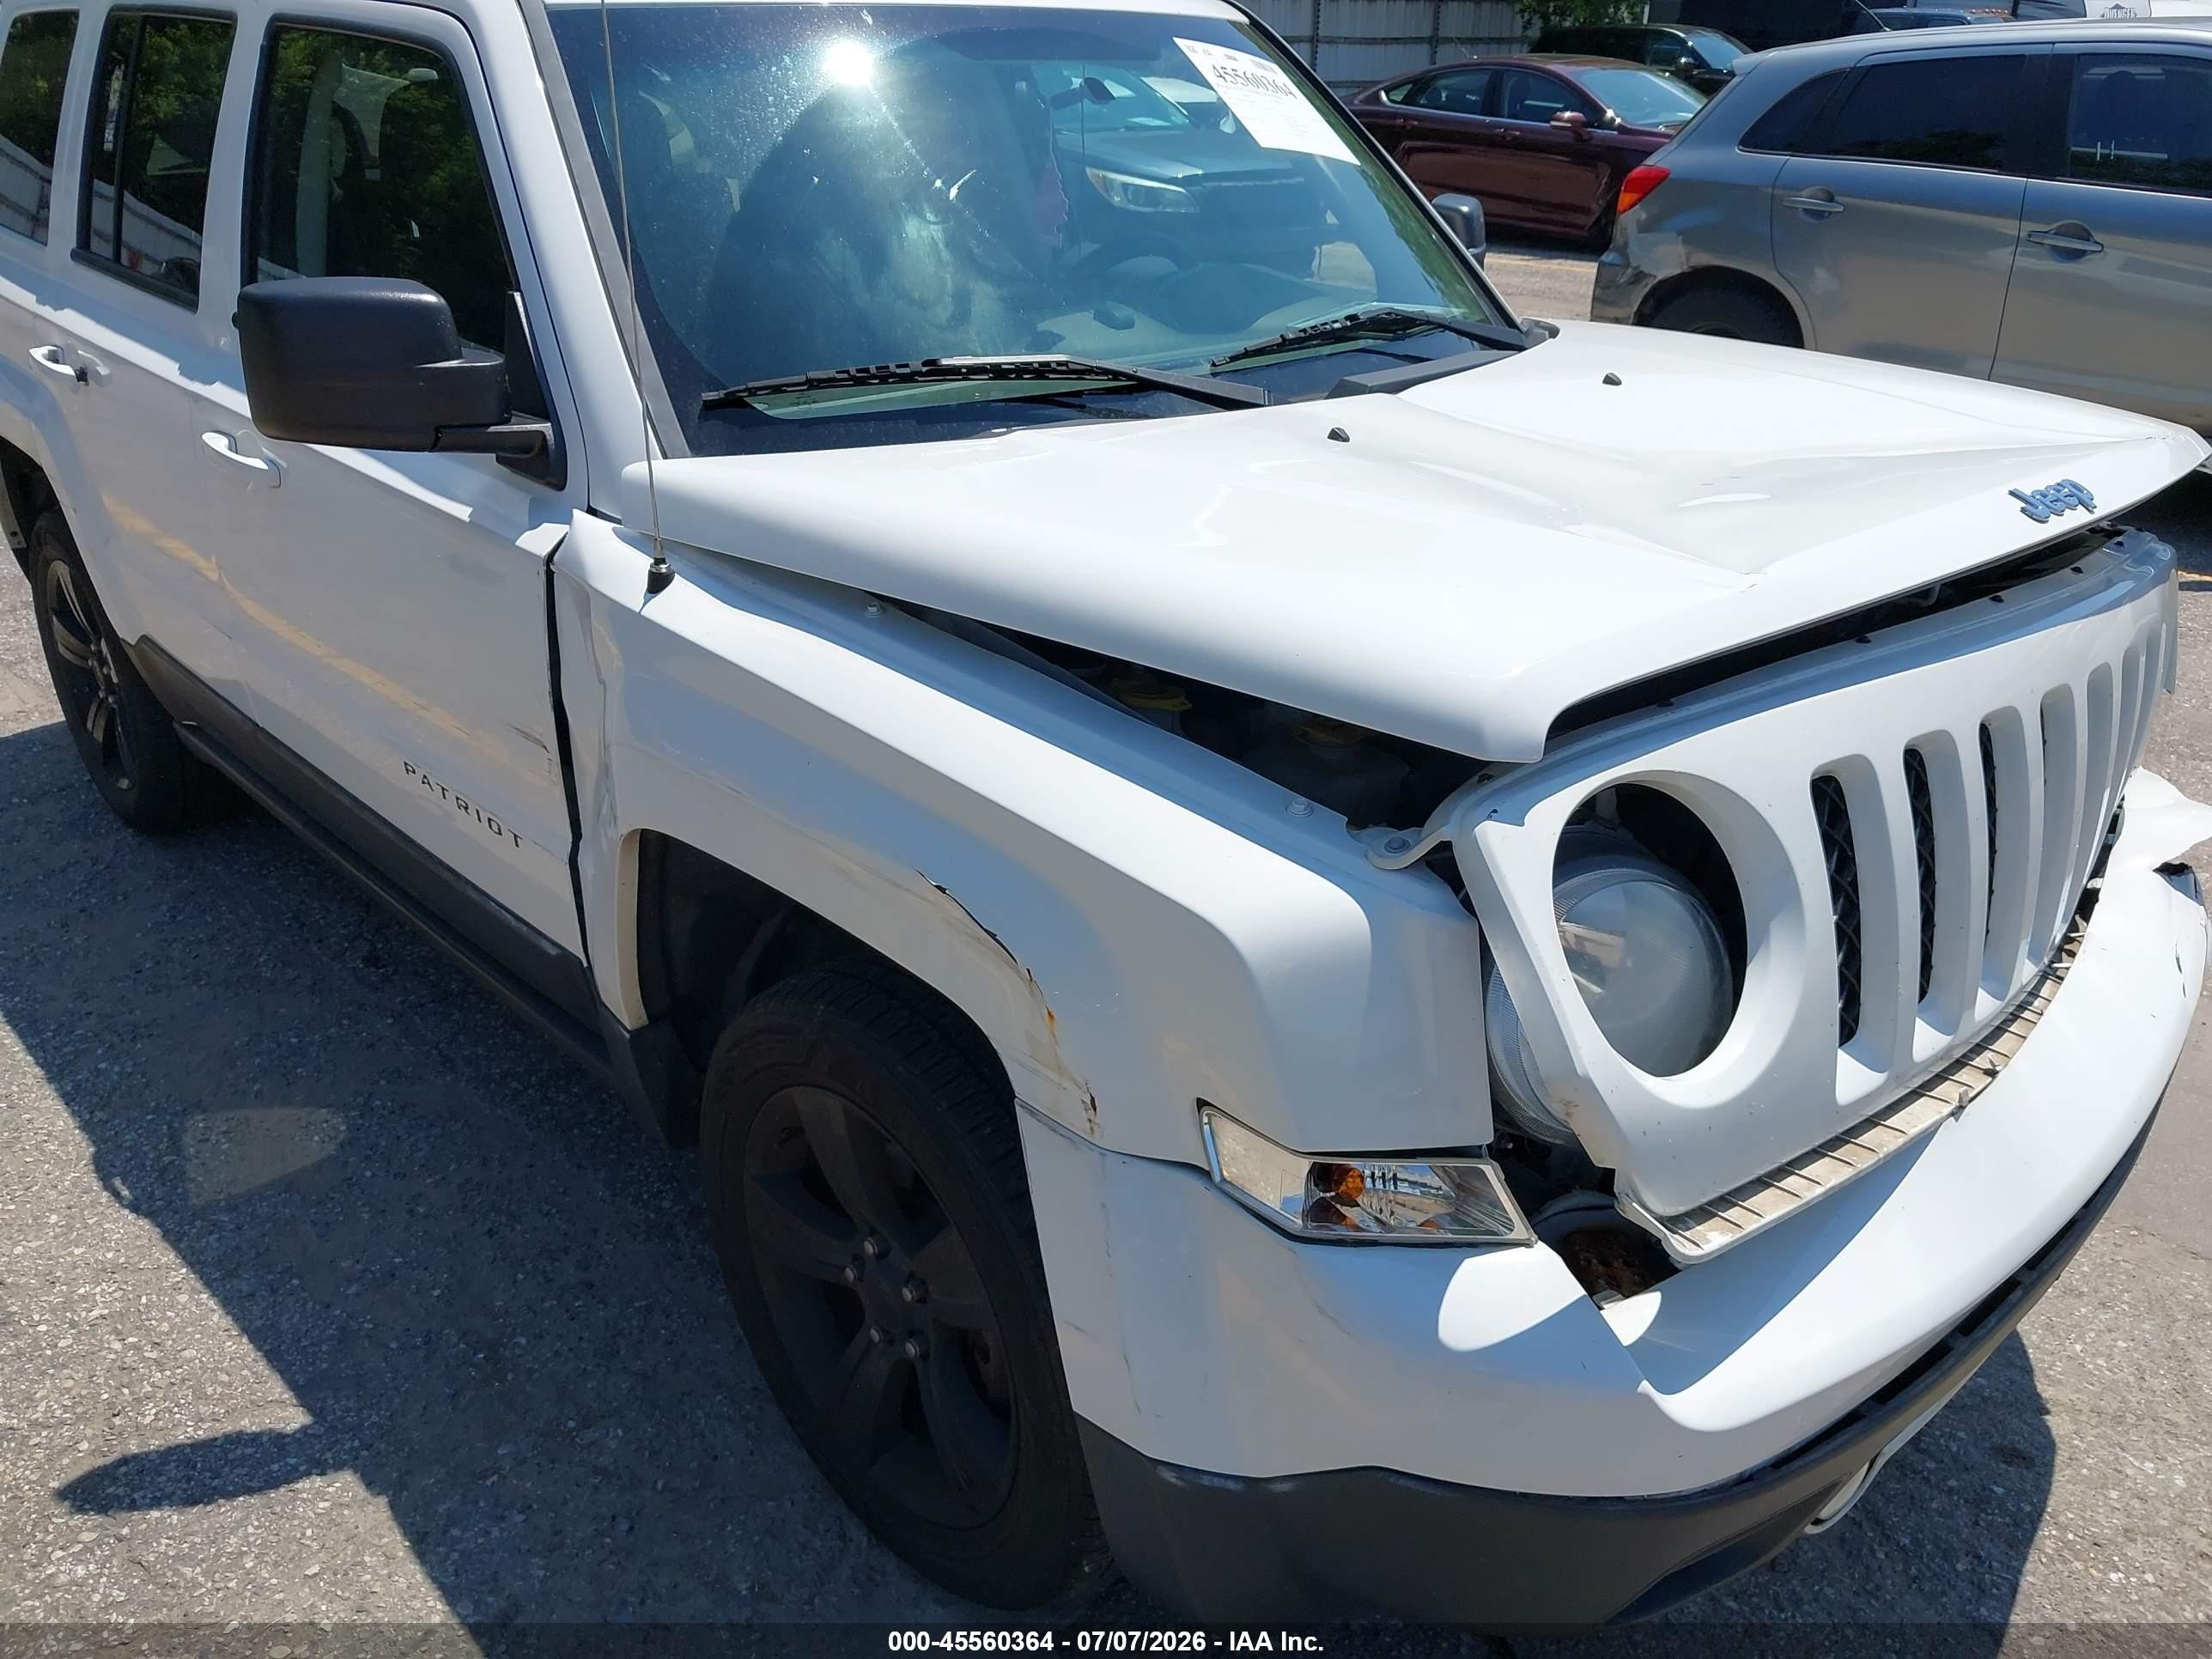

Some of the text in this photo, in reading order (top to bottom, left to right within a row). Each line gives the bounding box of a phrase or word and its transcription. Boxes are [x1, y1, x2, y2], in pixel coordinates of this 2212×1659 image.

[1212, 64, 1297, 100] 45560364
[2008, 478, 2097, 520] Jeep
[403, 760, 523, 848] PATRIOT
